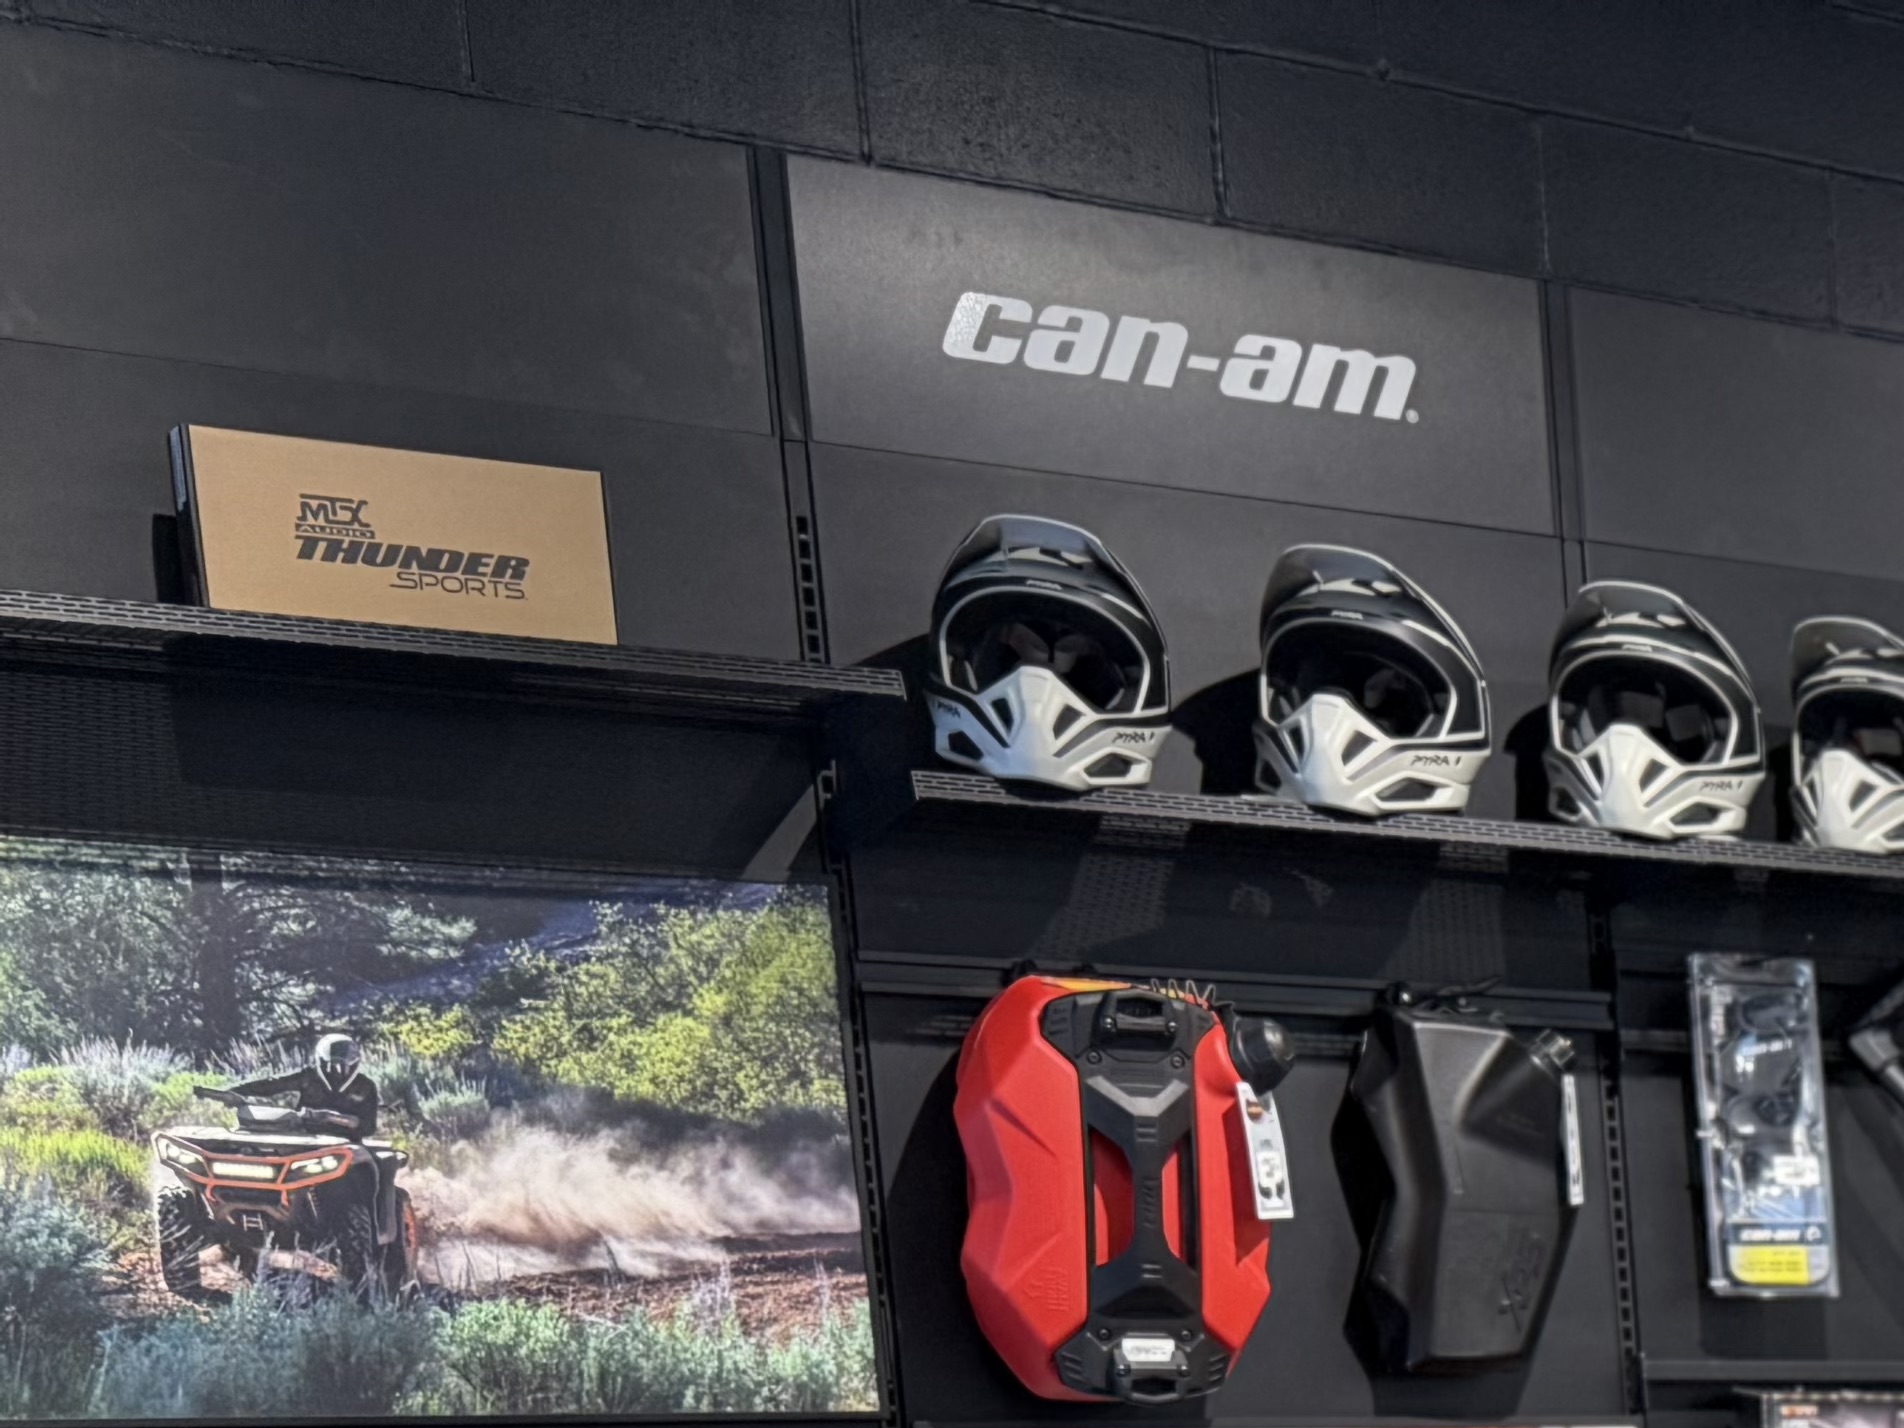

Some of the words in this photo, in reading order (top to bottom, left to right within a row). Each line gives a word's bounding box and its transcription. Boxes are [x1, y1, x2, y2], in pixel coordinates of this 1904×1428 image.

[942, 291, 1417, 420] can-am
[300, 523, 373, 540] AUDIO
[295, 534, 530, 581] THUNDER
[389, 571, 527, 600] SPORTS
